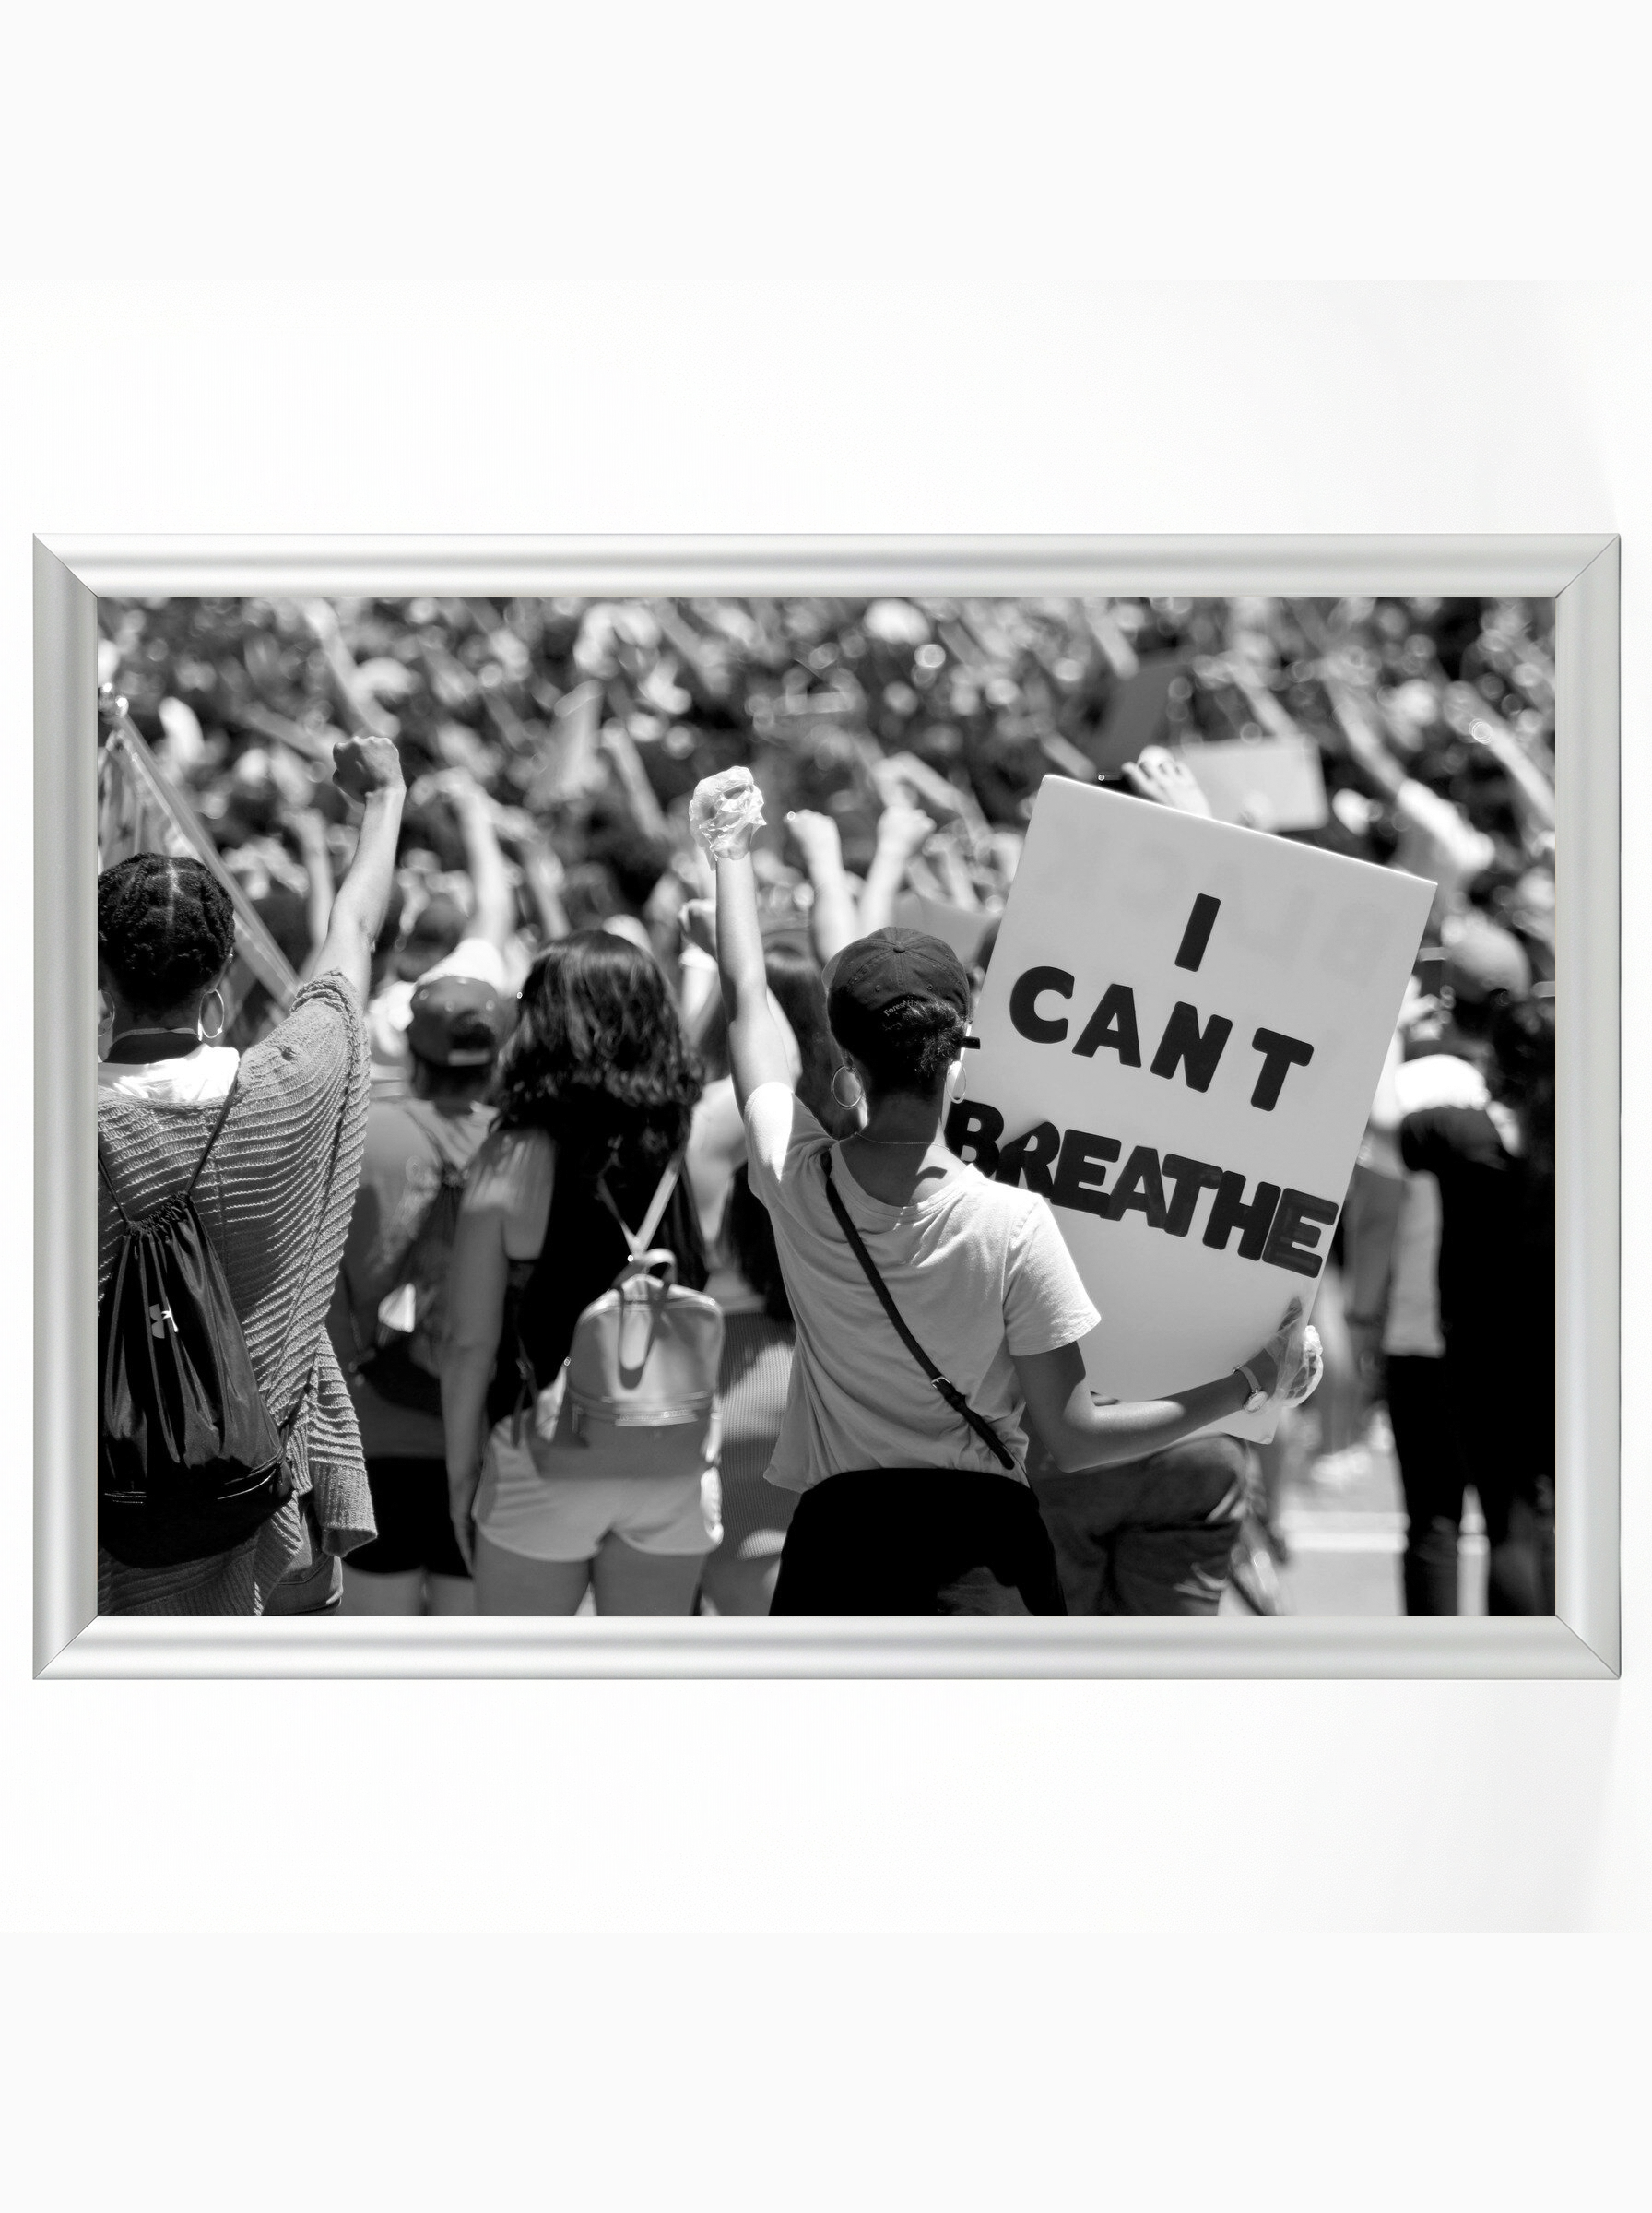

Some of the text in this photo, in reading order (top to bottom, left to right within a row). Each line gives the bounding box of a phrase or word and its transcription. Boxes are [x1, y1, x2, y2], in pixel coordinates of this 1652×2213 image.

[1175, 893, 1221, 972] I
[1009, 966, 1314, 1111] CANT
[944, 1099, 1339, 1278] BREATHE
